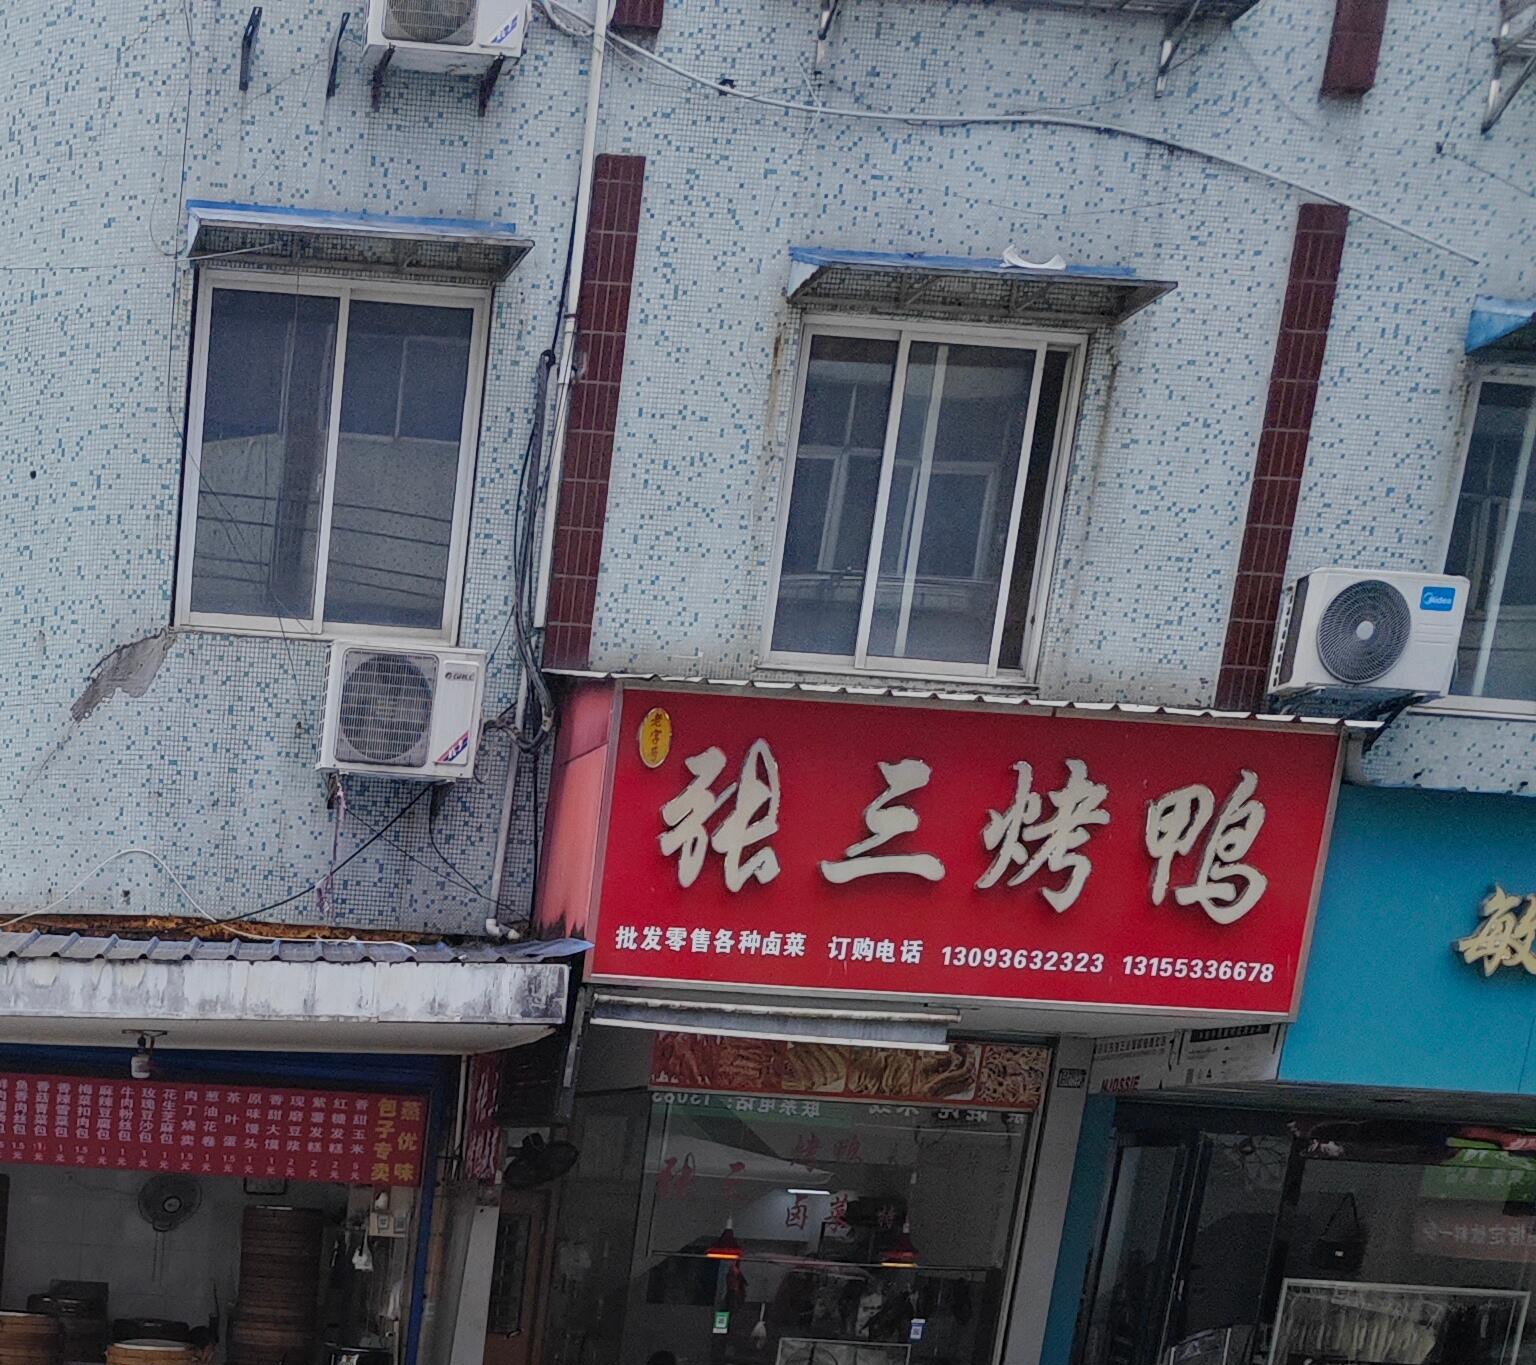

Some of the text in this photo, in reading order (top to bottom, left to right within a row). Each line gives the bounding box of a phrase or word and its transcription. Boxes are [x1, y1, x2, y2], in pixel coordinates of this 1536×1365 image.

[658, 737, 1268, 925] 张三烤鸭
[615, 925, 1275, 983] 批发零售各种卤菜 订购电话 13093632323 13155336678
[223, 1092, 241, 1147] 茶叶蛋
[371, 1098, 398, 1182] 包子专卖
